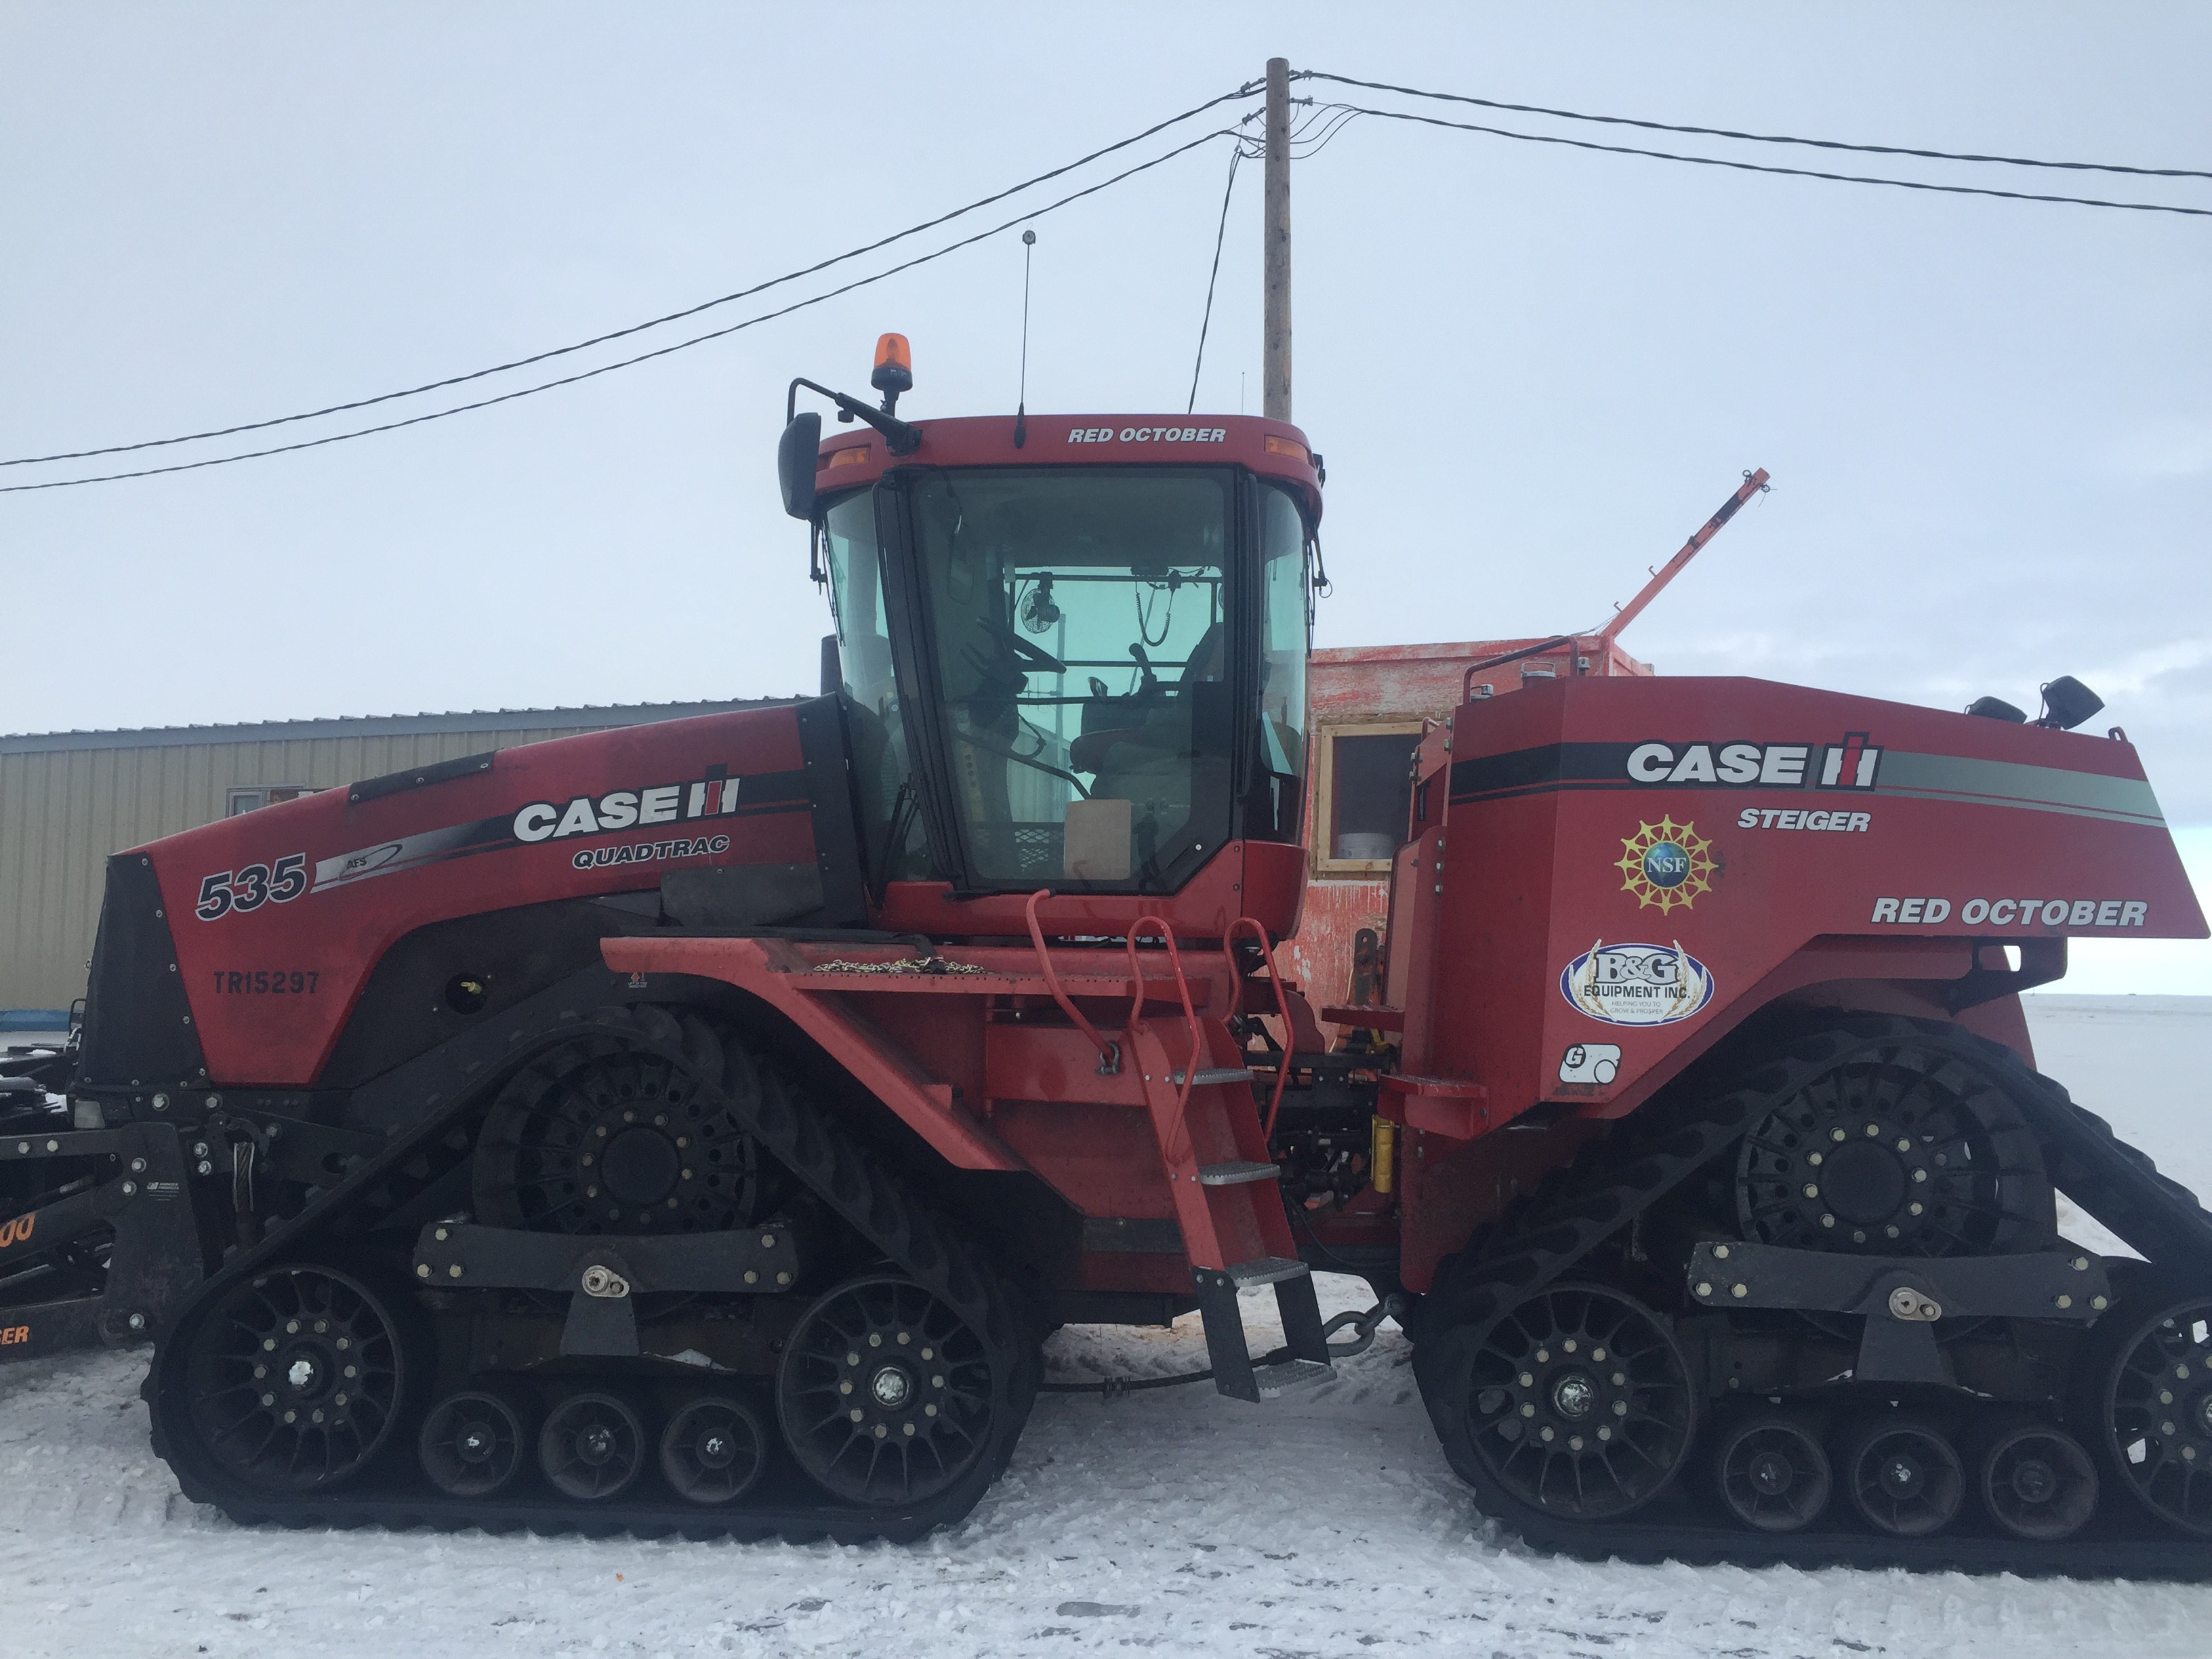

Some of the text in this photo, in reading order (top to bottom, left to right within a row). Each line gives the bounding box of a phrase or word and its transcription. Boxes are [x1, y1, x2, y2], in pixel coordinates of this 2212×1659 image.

[1067, 428, 1227, 443] RED OCTOBER
[1626, 743, 1809, 784] CASE
[513, 785, 680, 842] CASE
[1737, 808, 1871, 832] STEIGER
[346, 857, 367, 869] AFS
[572, 835, 731, 869] QUADTRAC
[1647, 857, 1687, 874] NSF
[195, 852, 307, 922] 535
[1870, 897, 2149, 927] RED OCTOBER
[1593, 952, 1683, 986] B&G
[213, 970, 319, 994] TR15297
[1584, 985, 1690, 999] EQUIPMENT INC.
[0, 1326, 30, 1345] ER
